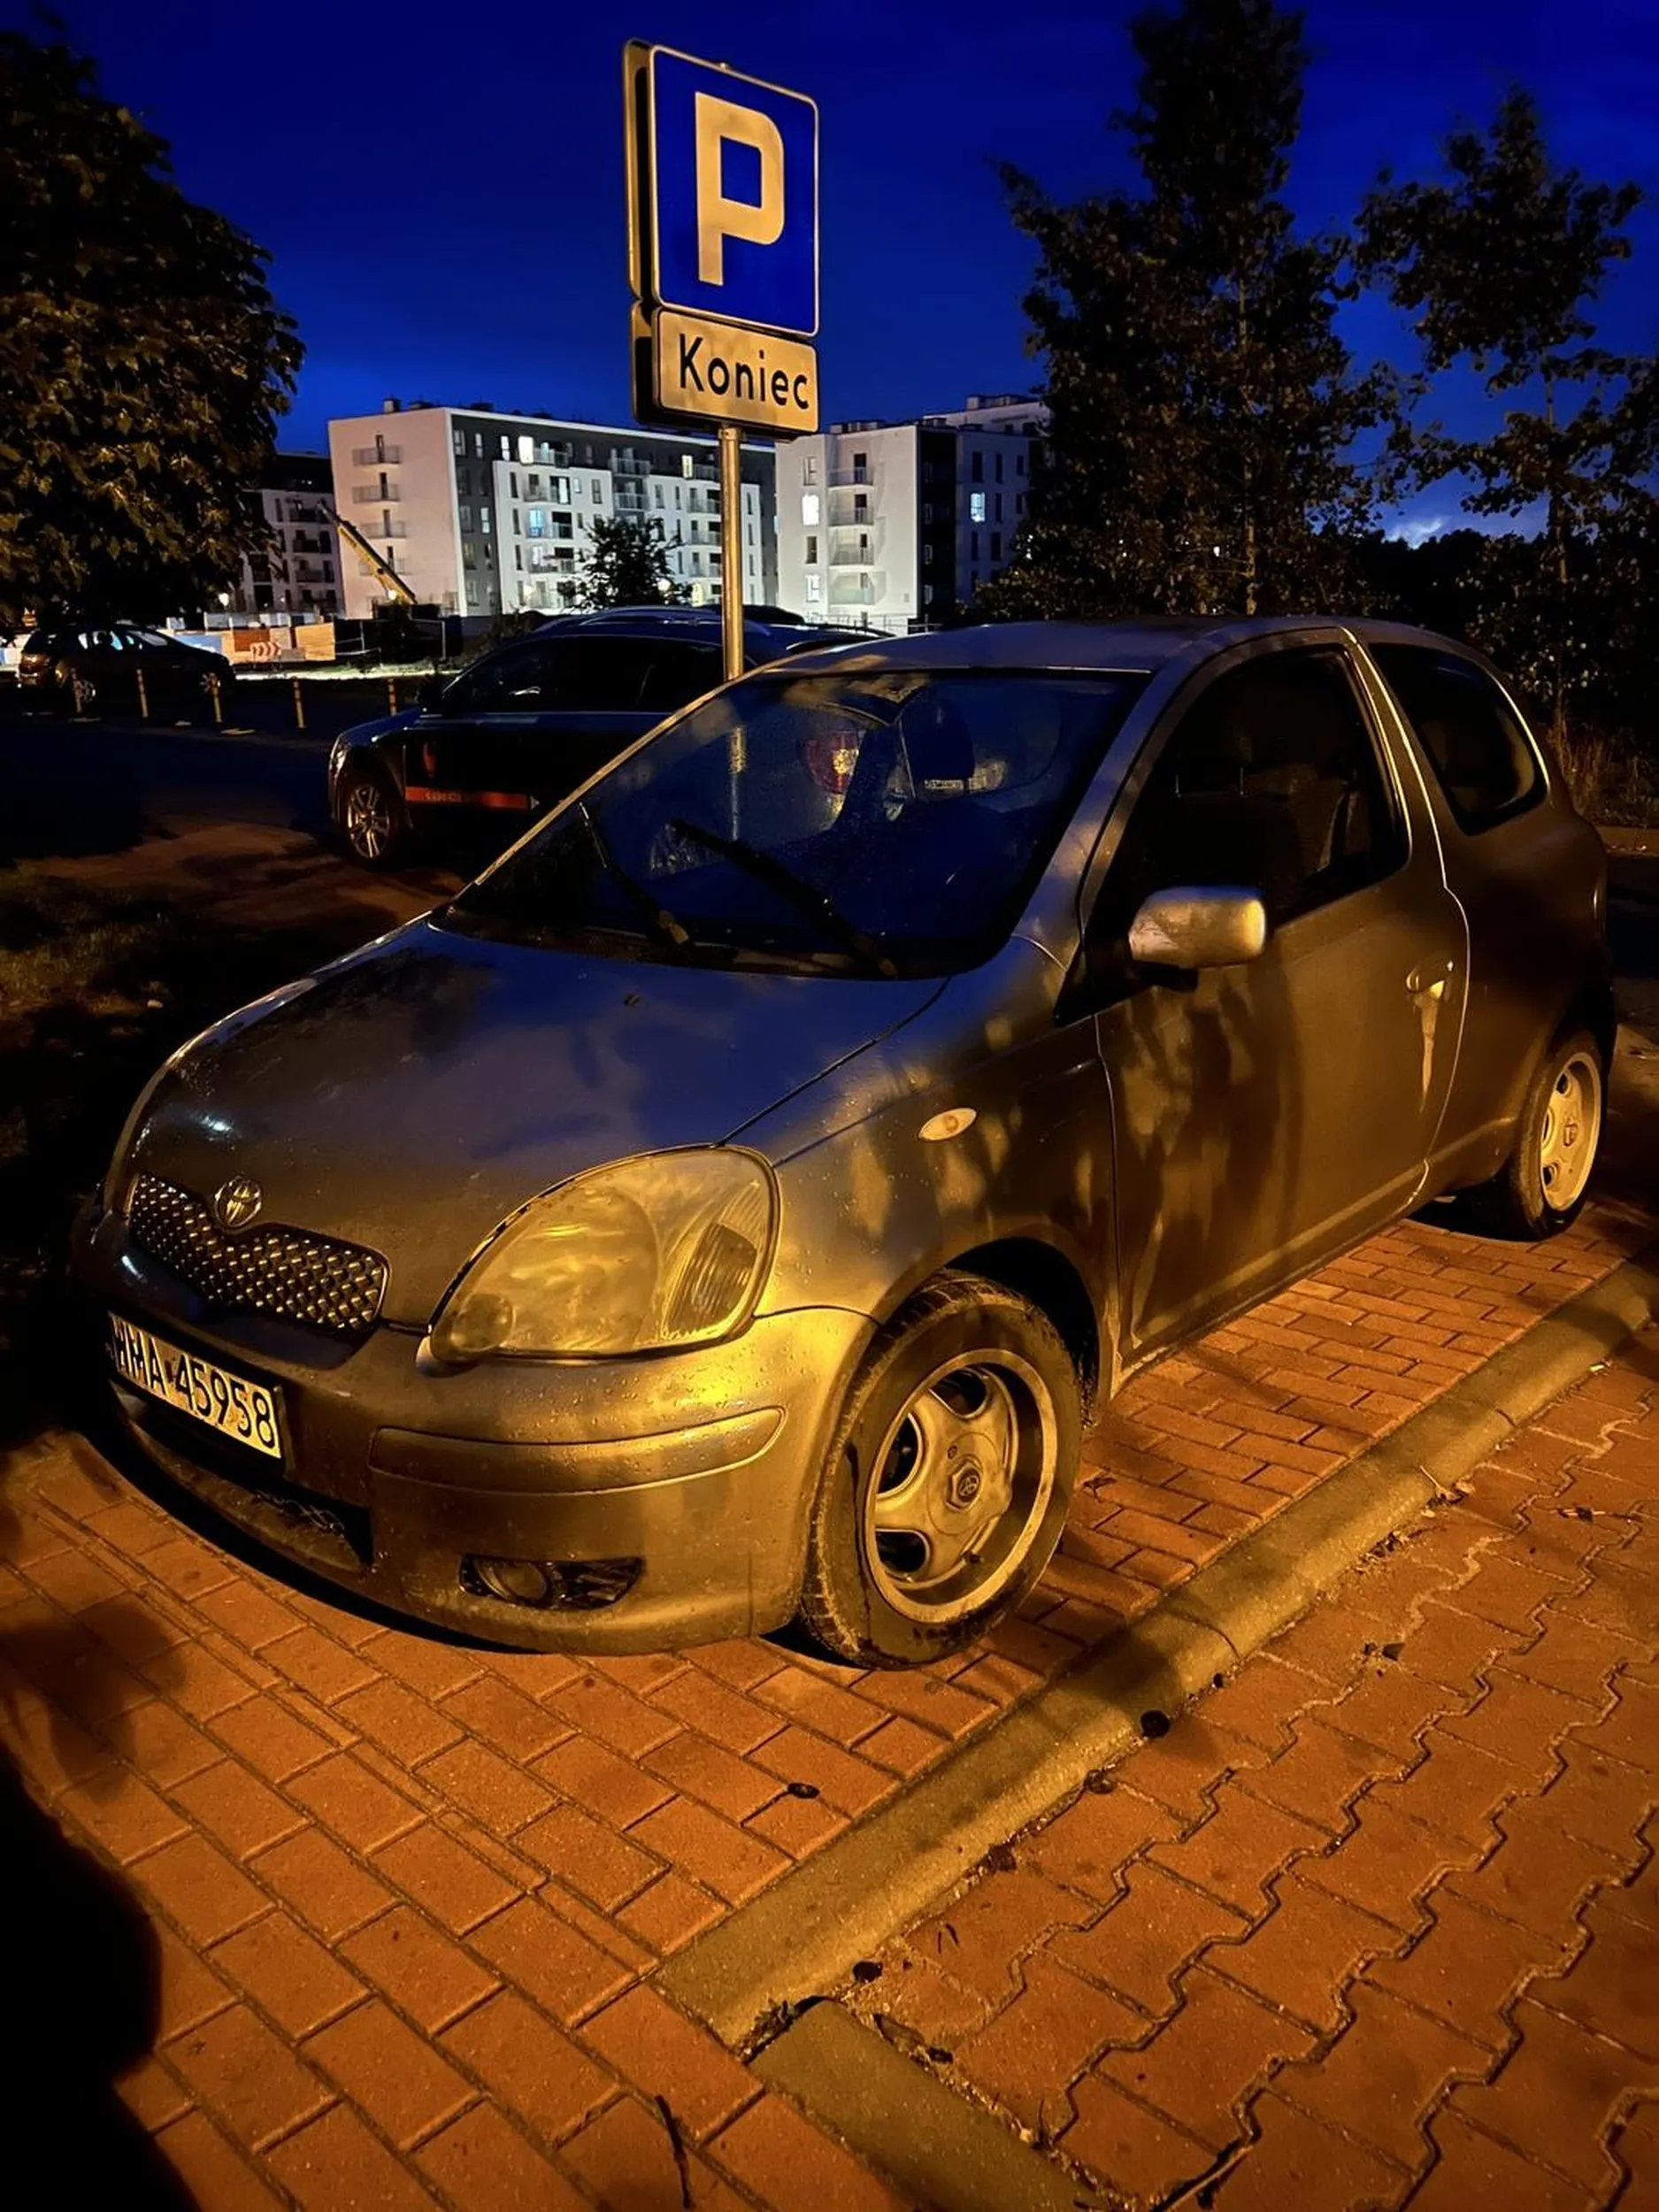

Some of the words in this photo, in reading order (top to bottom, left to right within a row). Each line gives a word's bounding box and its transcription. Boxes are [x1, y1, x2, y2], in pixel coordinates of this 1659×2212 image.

[695, 91, 784, 286] P
[679, 333, 809, 410] Koniec
[176, 1355, 275, 1449] 45958
